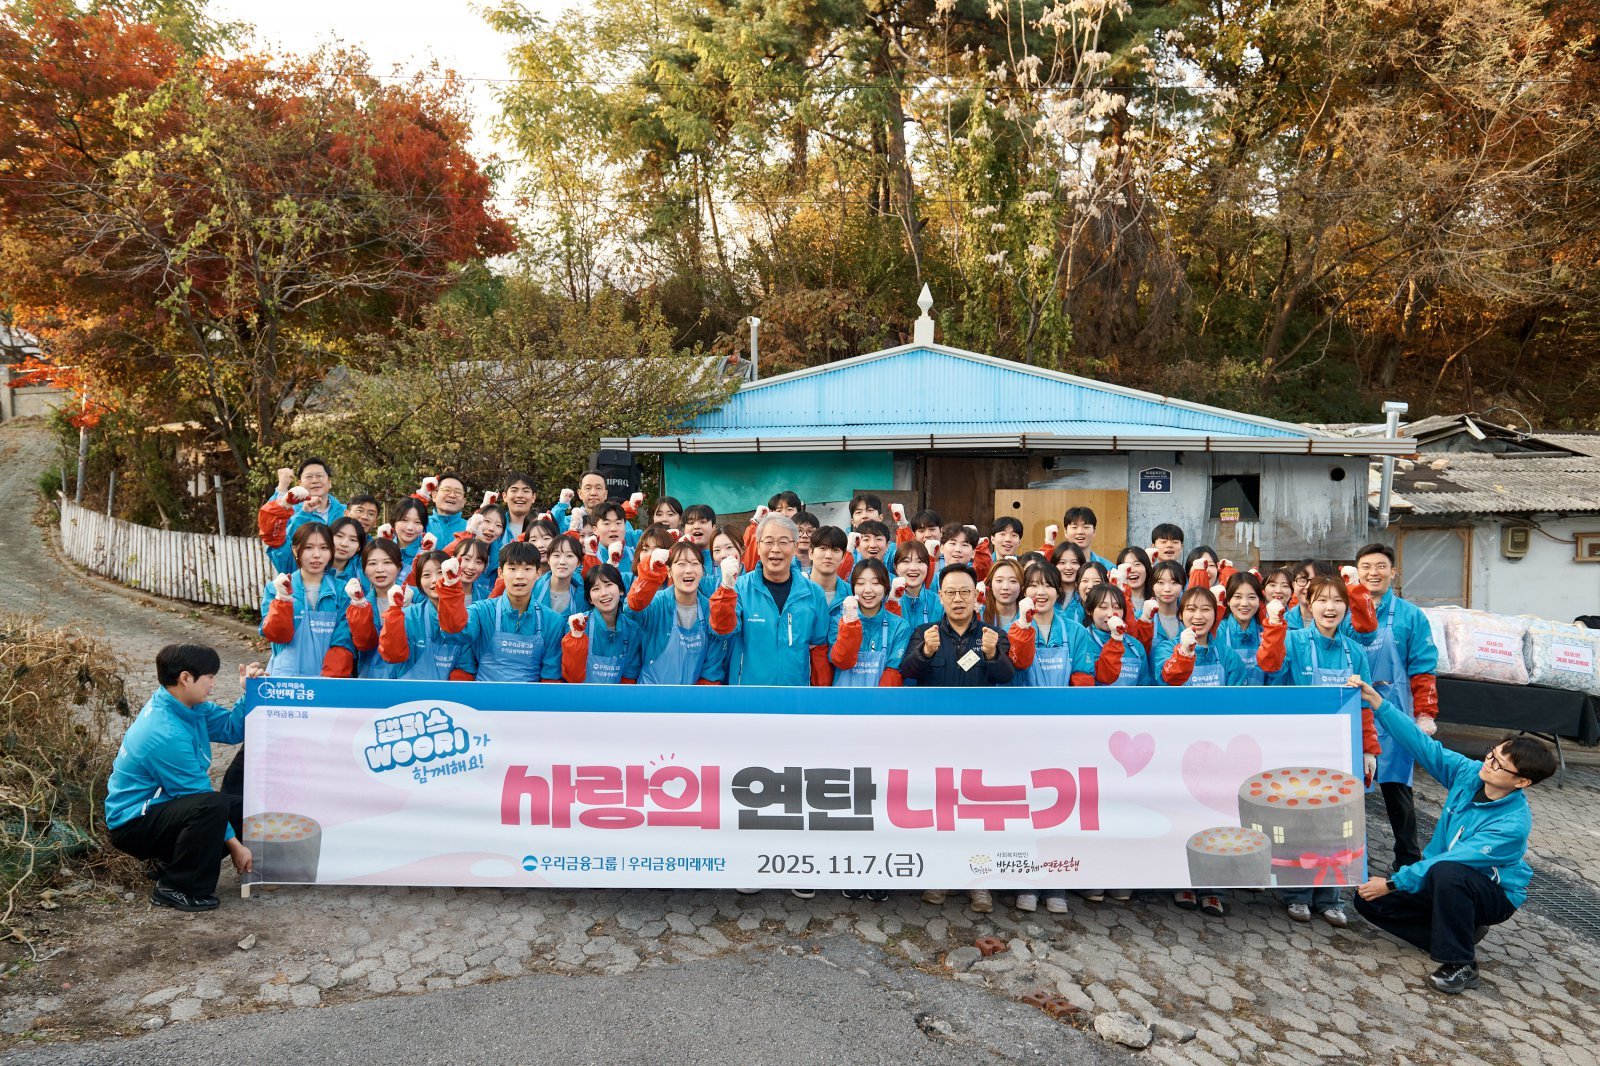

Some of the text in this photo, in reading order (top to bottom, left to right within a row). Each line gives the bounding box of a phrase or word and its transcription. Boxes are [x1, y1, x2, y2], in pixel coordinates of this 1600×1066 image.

[1148, 480, 1162, 490] 46
[266, 688, 315, 700] 첫번째 금융
[266, 709, 309, 719] 우리금융그룹
[375, 707, 453, 744] 캠퍼스
[365, 727, 491, 773] WOORI 가
[412, 753, 484, 784] 함께해요!
[500, 764, 1100, 831] 사랑의 연탄 나누기
[540, 855, 727, 872] 우리금융그룹 우리금융미래재단
[757, 852, 924, 878] 2025. 11.7.(금)
